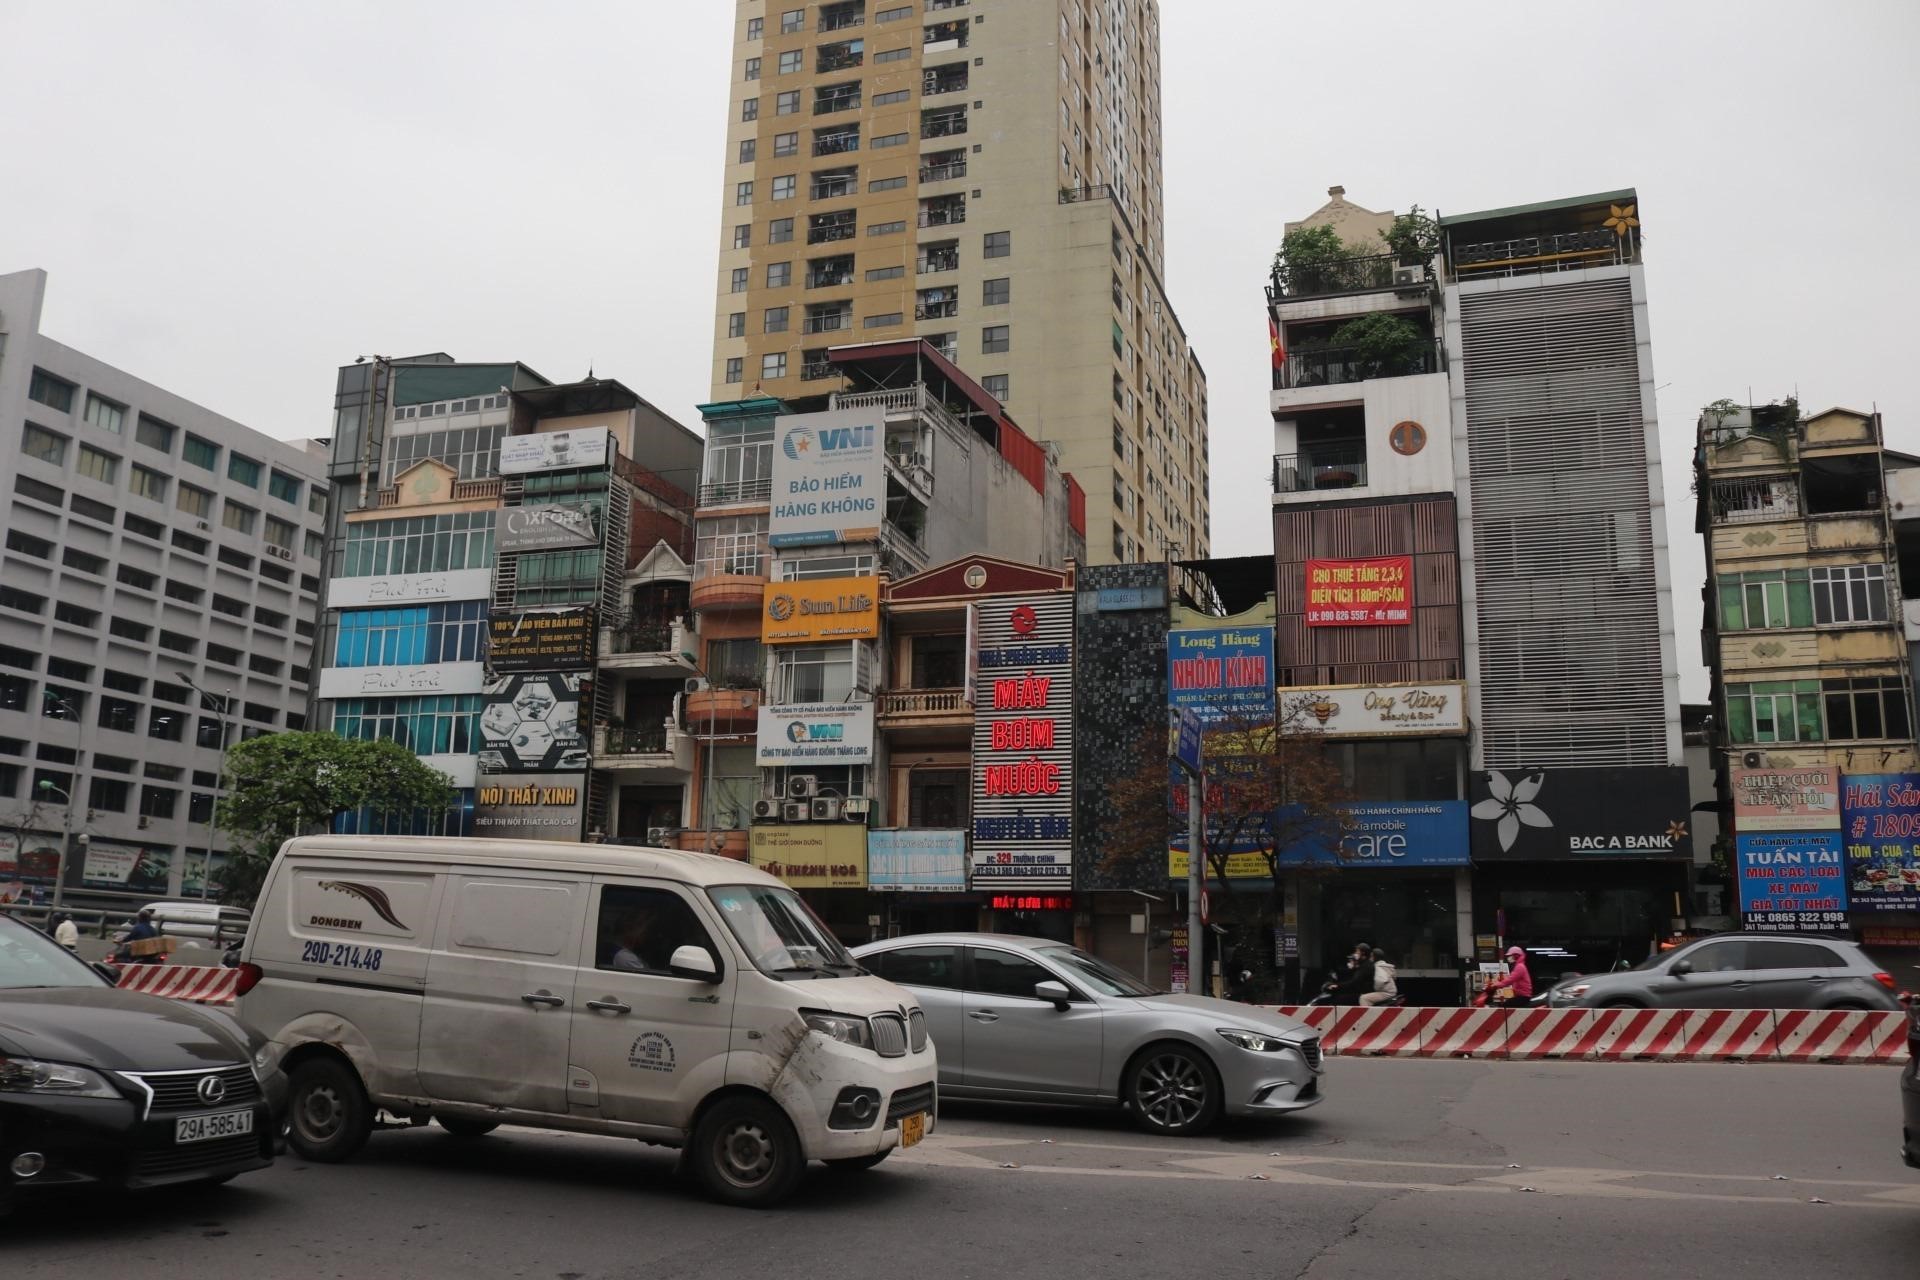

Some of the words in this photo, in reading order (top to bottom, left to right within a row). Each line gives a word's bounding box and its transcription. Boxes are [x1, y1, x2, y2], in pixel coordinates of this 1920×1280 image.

[818, 425, 875, 451] VNI
[790, 477, 820, 493] BẢO
[825, 472, 863, 491] HIỂM
[775, 501, 817, 518] HÀNG
[821, 496, 876, 515] KHÔNG
[1313, 568, 1331, 583] CHO
[1333, 564, 1354, 583] THUÊ
[1356, 562, 1379, 582] TẦNG
[800, 598, 835, 616] Sun
[838, 594, 872, 613] Life
[1311, 586, 1331, 606] DIỆN
[1334, 586, 1353, 603] TÍCH
[1308, 611, 1319, 621] LH:
[1180, 635, 1217, 649] Long
[1222, 631, 1260, 648] Hằng
[1172, 651, 1222, 690] NHÔM
[1226, 649, 1266, 688] KÍNH
[993, 669, 1051, 709] MÁY
[1364, 690, 1396, 718] Ong
[809, 723, 844, 739] VNI
[991, 716, 1055, 751] BƠM
[985, 755, 1060, 796] NƯỚC
[480, 783, 504, 809] NỘI
[507, 783, 540, 806] THẤT
[542, 787, 577, 806] XINH
[1845, 783, 1883, 809] Hải
[1367, 804, 1390, 816] HÀNH
[1391, 803, 1418, 816] CHÍNH
[476, 816, 493, 827] SIÊU
[494, 817, 506, 827] THỊ
[507, 816, 521, 827] NỘI
[522, 815, 542, 827] THẤT
[543, 817, 560, 827] CAO
[561, 814, 577, 826] CẤP
[1370, 819, 1407, 832] mobile
[1569, 835, 1605, 850] BAC
[1608, 835, 1622, 849] A
[1624, 834, 1674, 849] BANK
[1848, 843, 1872, 858] TÔM
[1882, 845, 1902, 858] CUA
[1745, 846, 1802, 865] TUẤN
[1806, 847, 1839, 863] TÀI
[1745, 867, 1776, 879] MUA
[1778, 864, 1806, 878] CÁC
[1768, 882, 1786, 894] XE
[1788, 880, 1819, 894] MÁY
[1751, 897, 1775, 911] GIÁ
[1776, 896, 1800, 911] TỐT
[1804, 894, 1841, 910] NHẤT
[310, 915, 363, 930] DONGBEN
[1745, 923, 1756, 931] 341
[1778, 922, 1795, 930] Chinh
[1800, 922, 1818, 930] Thanh
[1748, 913, 1766, 923] LH:
[1768, 912, 1796, 923] 0865
[1798, 912, 1820, 922] 322
[1822, 912, 1845, 922] 998
[1285, 937, 1297, 947] 335
[302, 940, 383, 971] 29D-214.48
[179, 1112, 251, 1140] 29A-585.41
